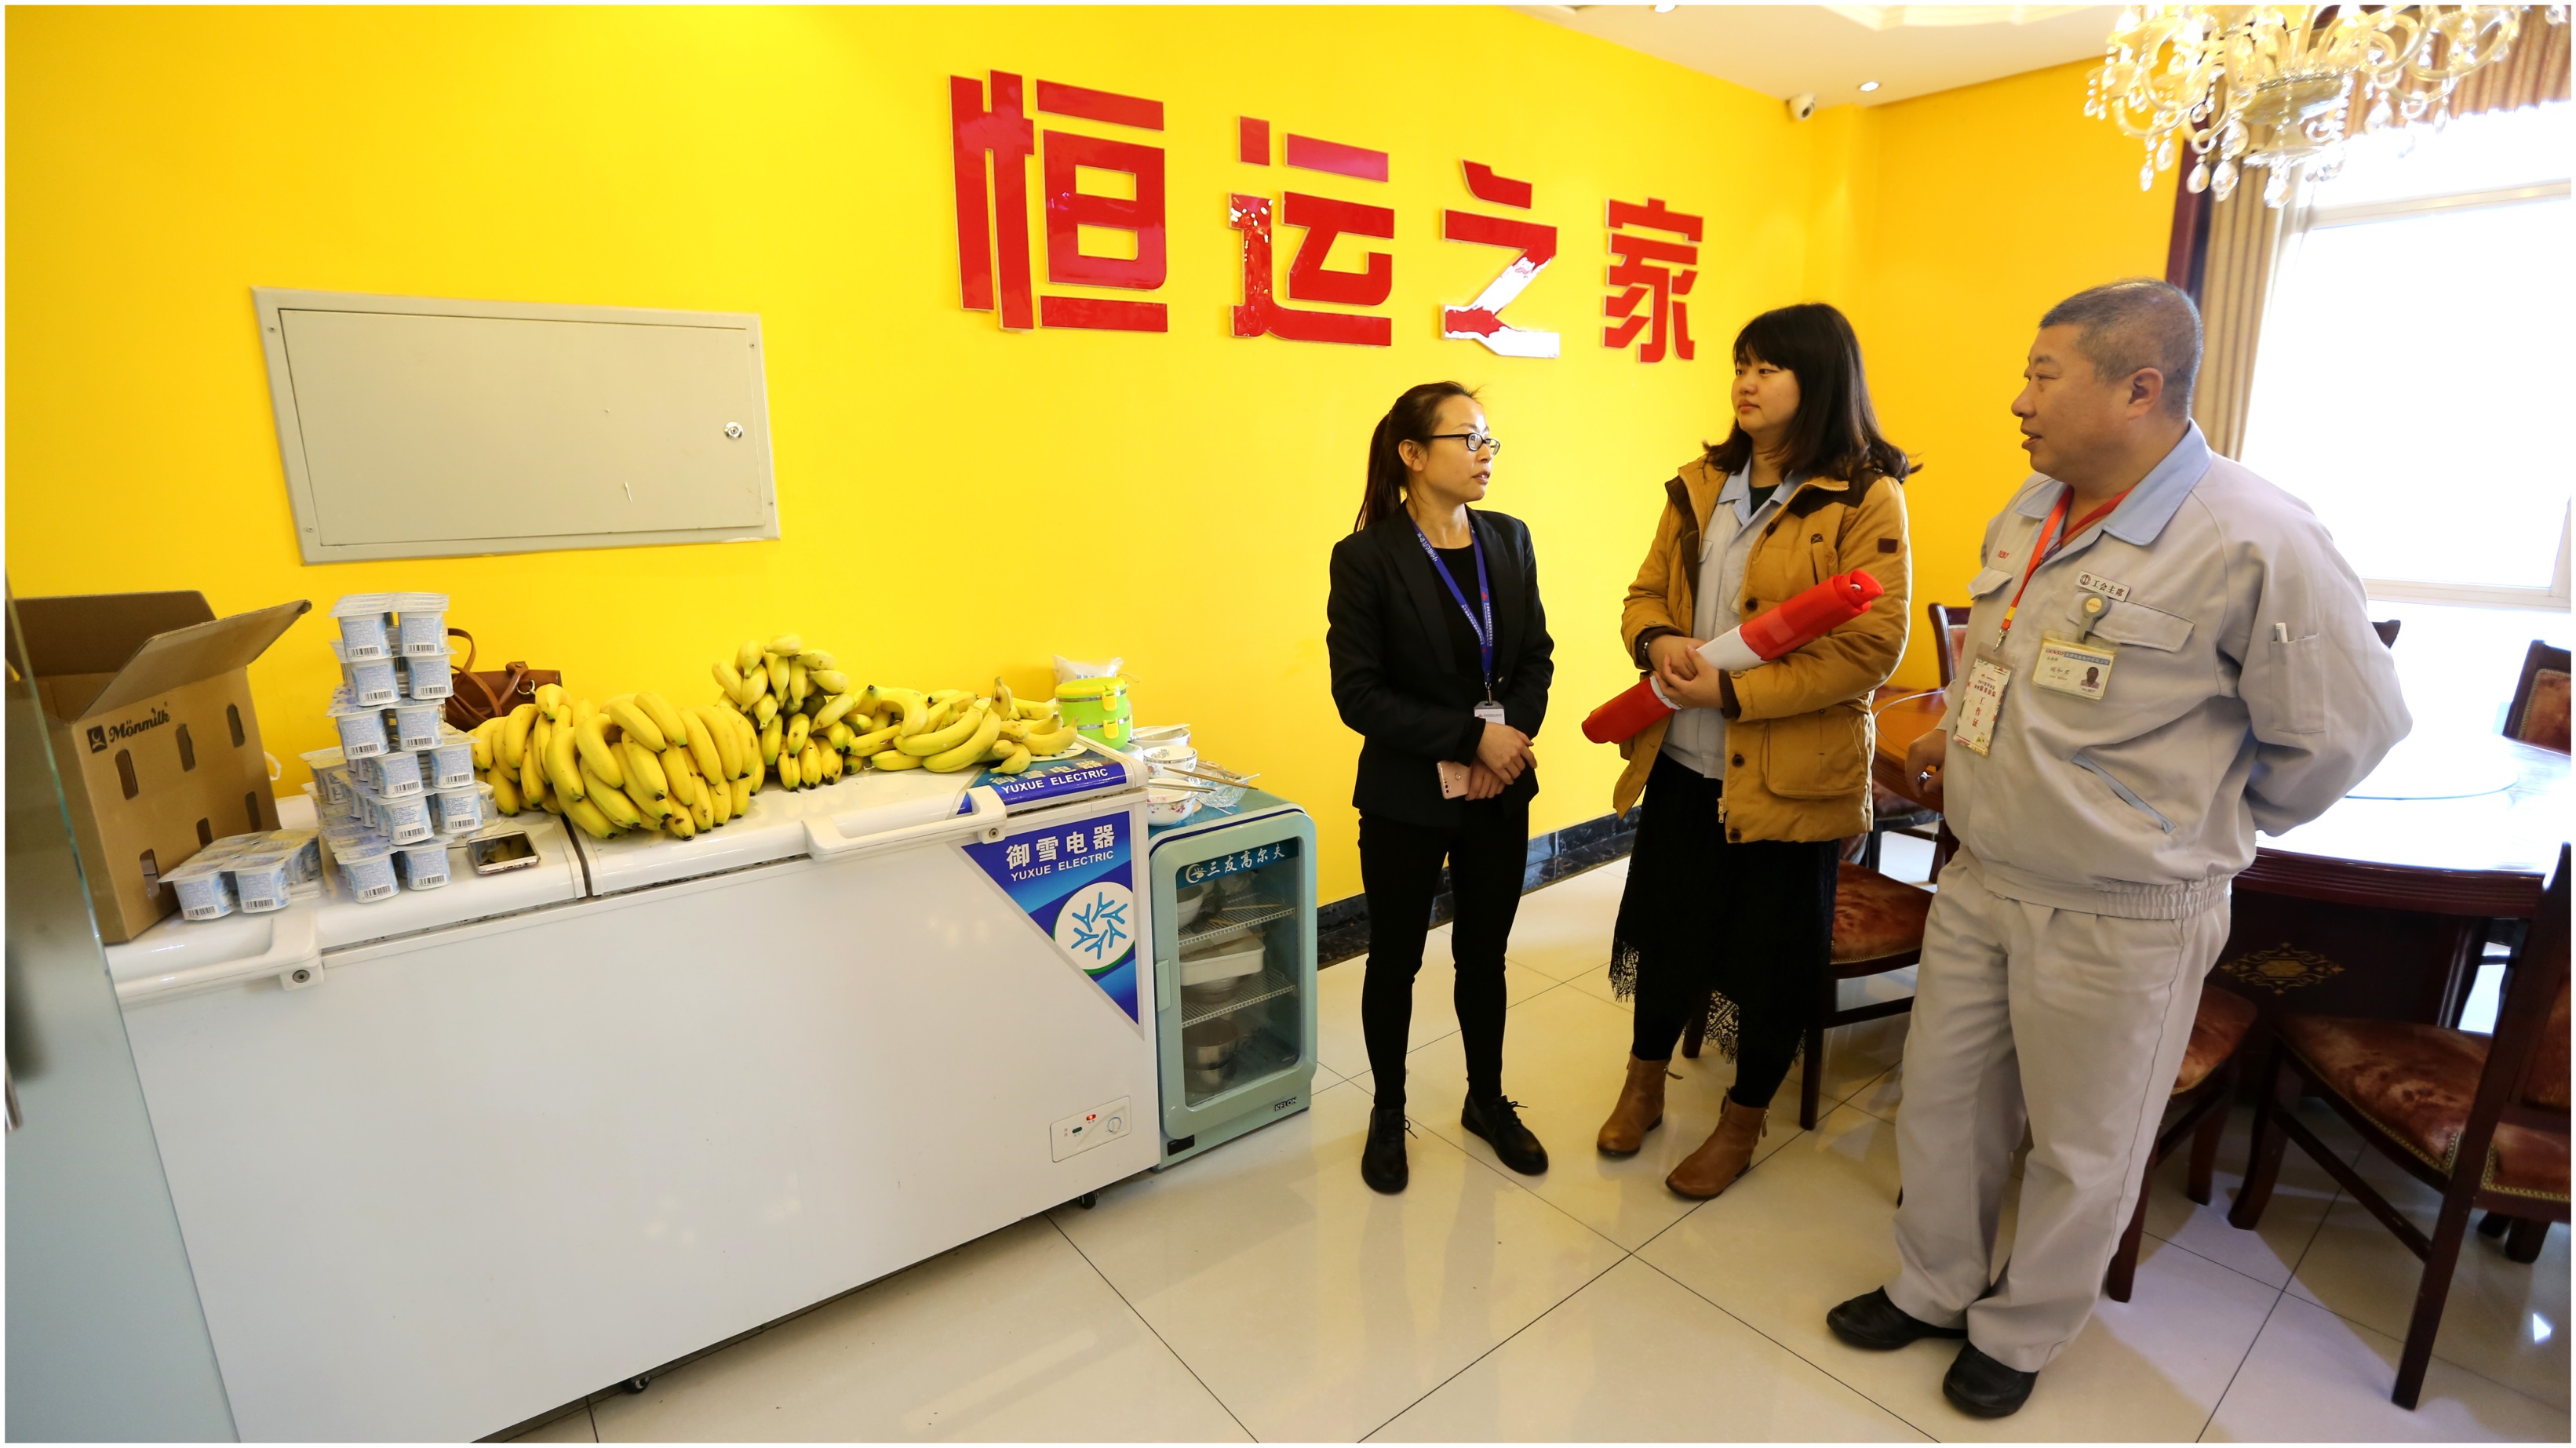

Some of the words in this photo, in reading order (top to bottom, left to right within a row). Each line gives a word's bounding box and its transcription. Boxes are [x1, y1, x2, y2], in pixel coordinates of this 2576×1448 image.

[949, 69, 1704, 363] 恒运之家
[2092, 579, 2126, 597] 工会主席
[108, 707, 170, 744] Mönmilk
[1000, 779, 1045, 795] YUXUE
[1050, 768, 1109, 786] ELECTRIC
[1005, 823, 1116, 870] 御雪电器
[1206, 843, 1285, 878] 三友高尔夫
[1011, 864, 1051, 882] YUXUE
[1058, 850, 1114, 871] ELECTRIC
